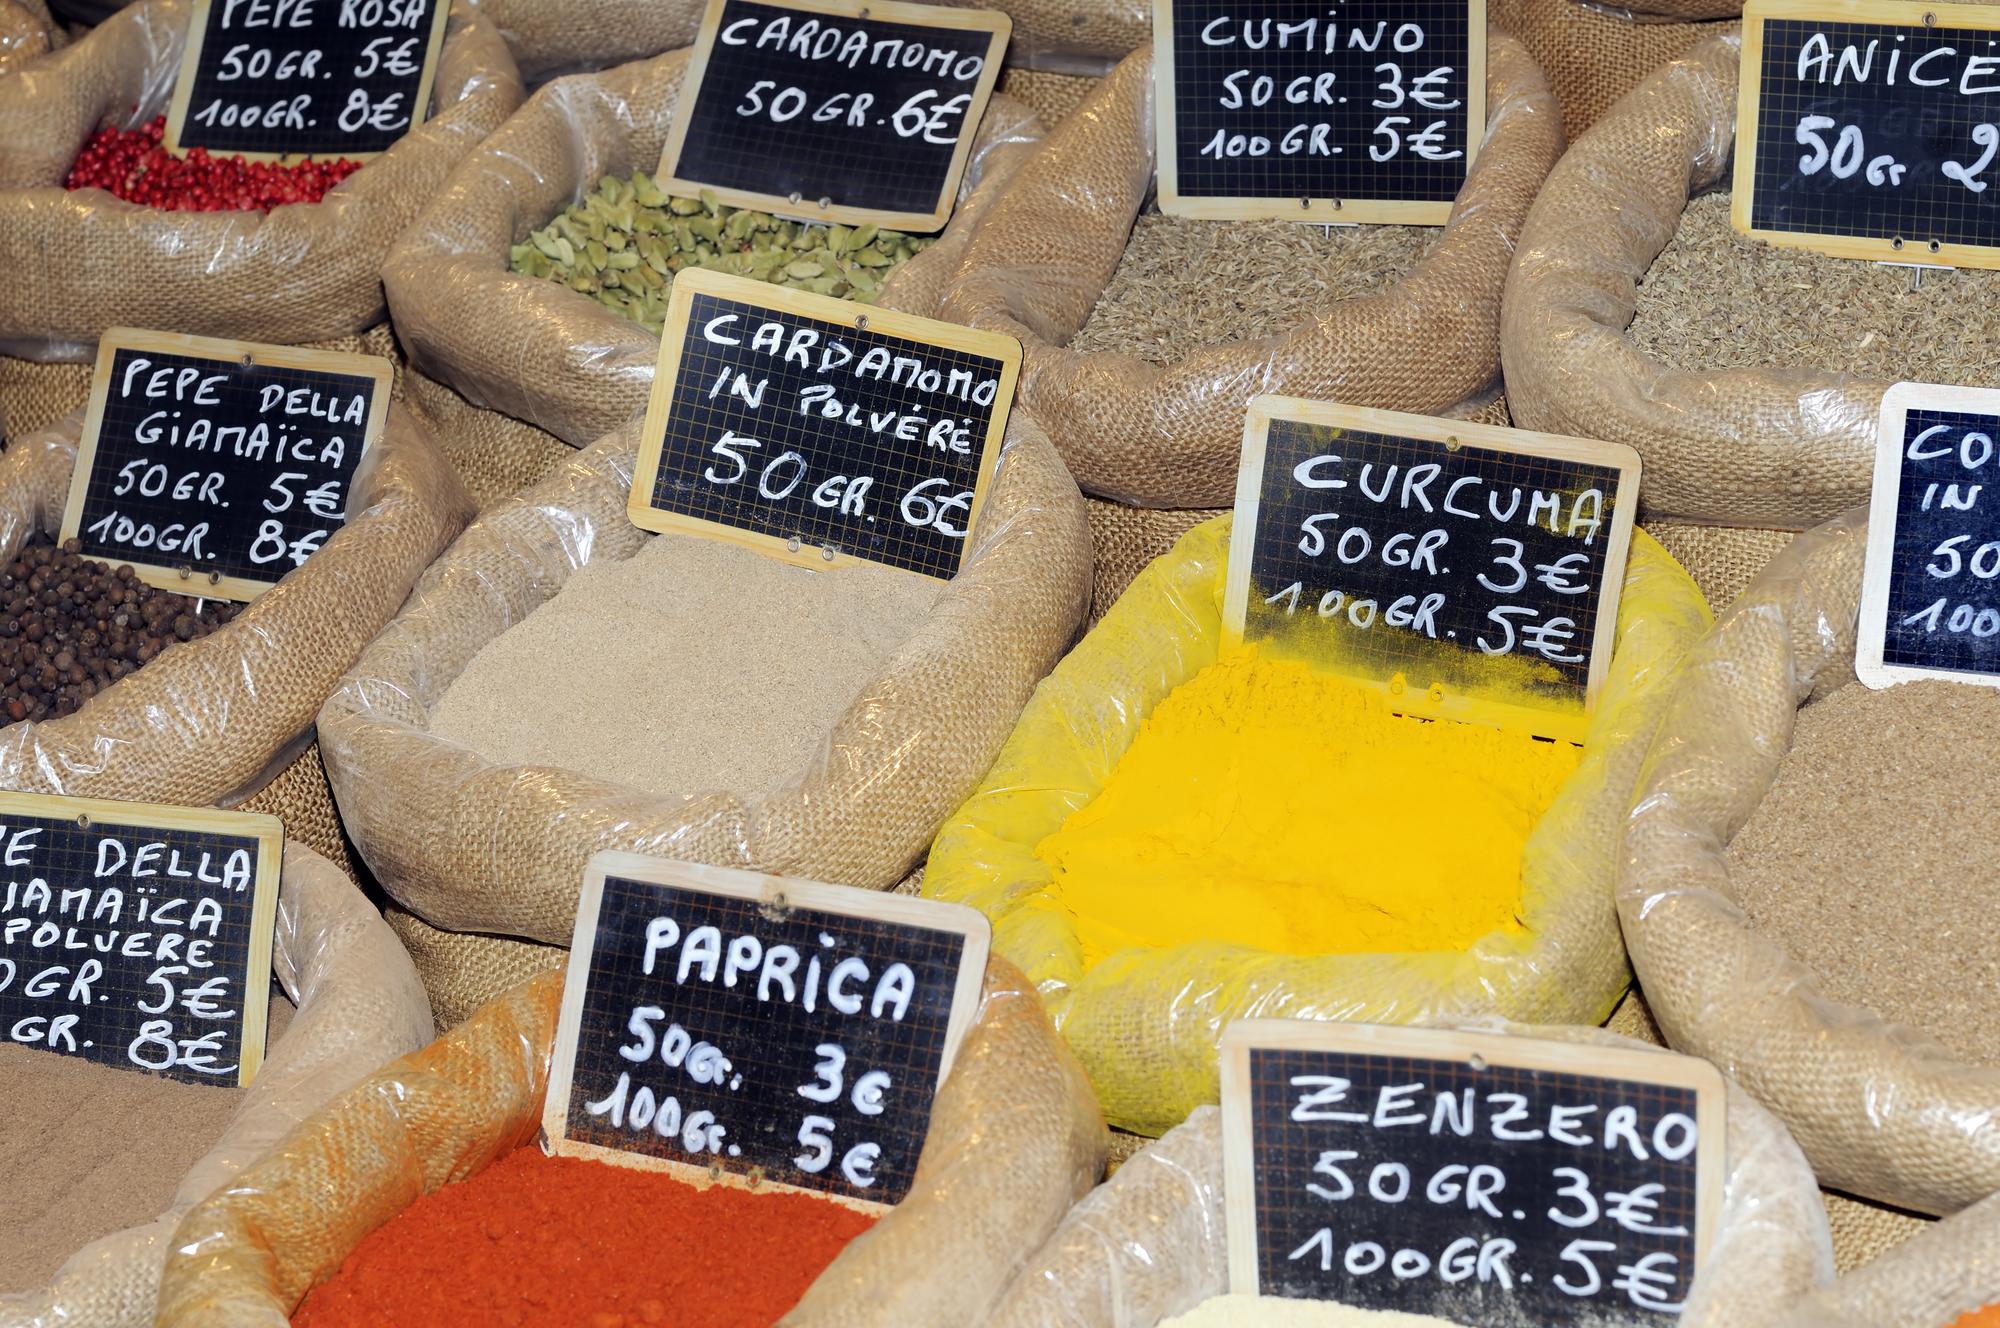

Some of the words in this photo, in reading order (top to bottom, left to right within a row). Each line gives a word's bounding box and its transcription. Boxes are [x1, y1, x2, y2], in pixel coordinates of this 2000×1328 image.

[218, 0, 314, 29] PEPE
[336, 0, 426, 29] ROSA
[720, 15, 984, 81] CARDAMOMO
[702, 313, 998, 407] CARDAMOMO
[707, 365, 769, 409] IN
[120, 357, 230, 406] PEPE
[258, 383, 366, 427] DELLA
[1292, 454, 1605, 546] CURCUMA
[1920, 482, 1983, 512] IN
[93, 837, 252, 893] DELLA
[3, 917, 215, 969] POLVERE
[1288, 1074, 1698, 1162] ZENZERO
